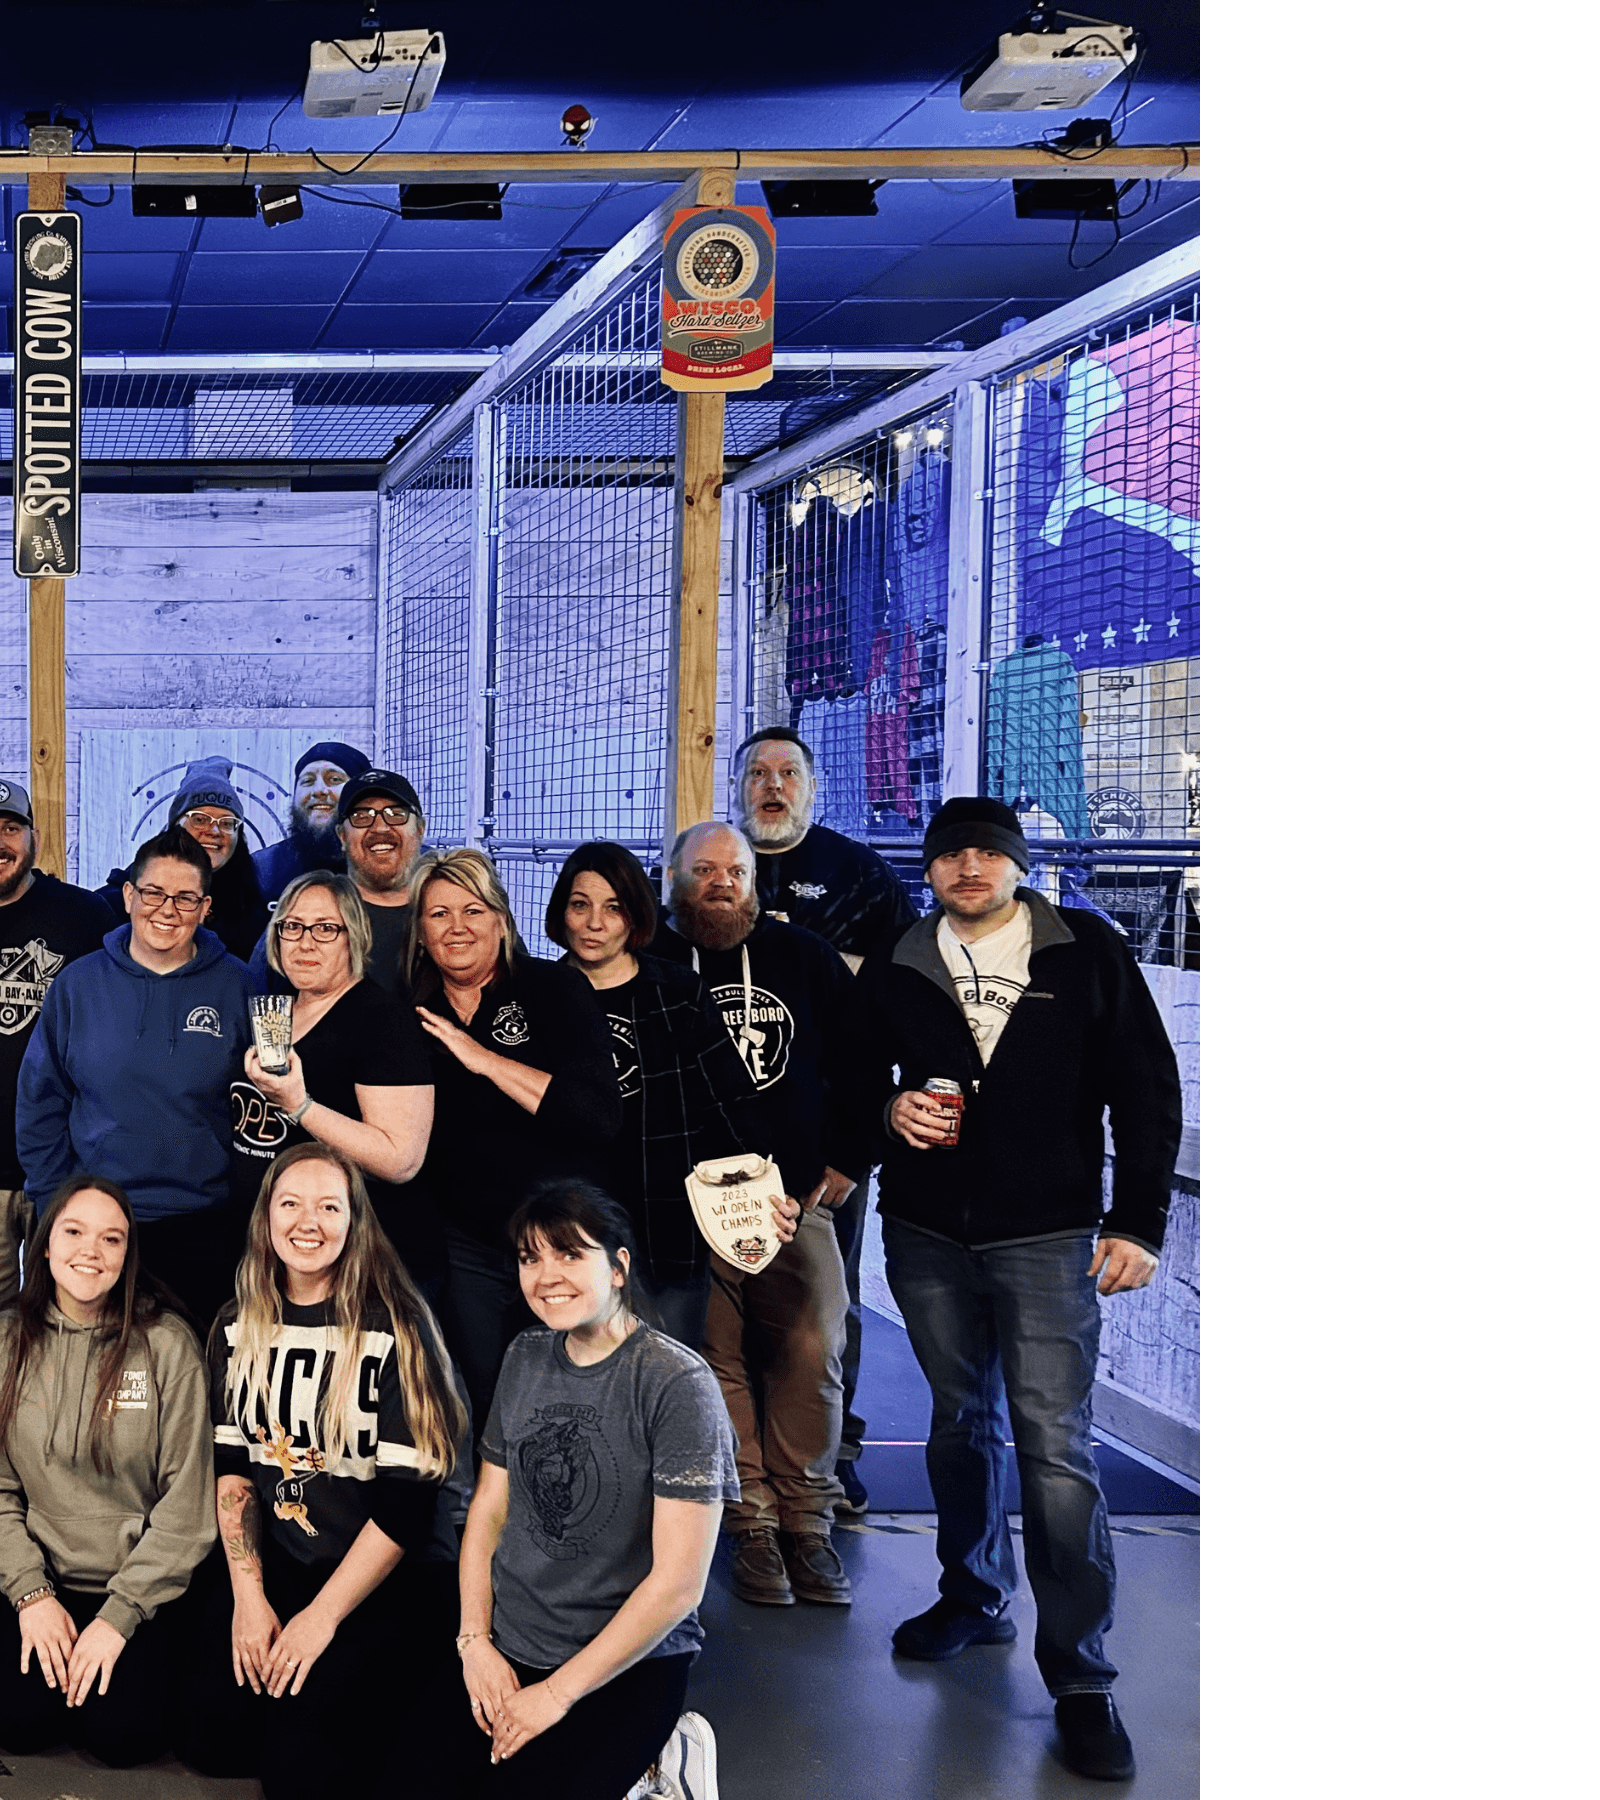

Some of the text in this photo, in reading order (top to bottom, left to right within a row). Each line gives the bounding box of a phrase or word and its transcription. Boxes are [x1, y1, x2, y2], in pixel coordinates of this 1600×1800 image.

[706, 231, 751, 257] HANDCRAFTED
[678, 300, 755, 315] WISCO
[670, 312, 761, 329] Hard Seltzer
[687, 364, 745, 373] DRINK LOCAL
[24, 288, 72, 516] SPOTTED COW
[31, 535, 44, 560] Only
[44, 516, 67, 568] Wisconsin!
[44, 539, 53, 549] in
[725, 989, 770, 1004] BULLEYES
[251, 1149, 275, 1158] MINUTE
[722, 1189, 748, 1201] 2023
[712, 1205, 727, 1216] WI
[721, 1215, 762, 1231] CHAMPS
[123, 1370, 147, 1380] FONDY
[132, 1380, 147, 1390] AXE
